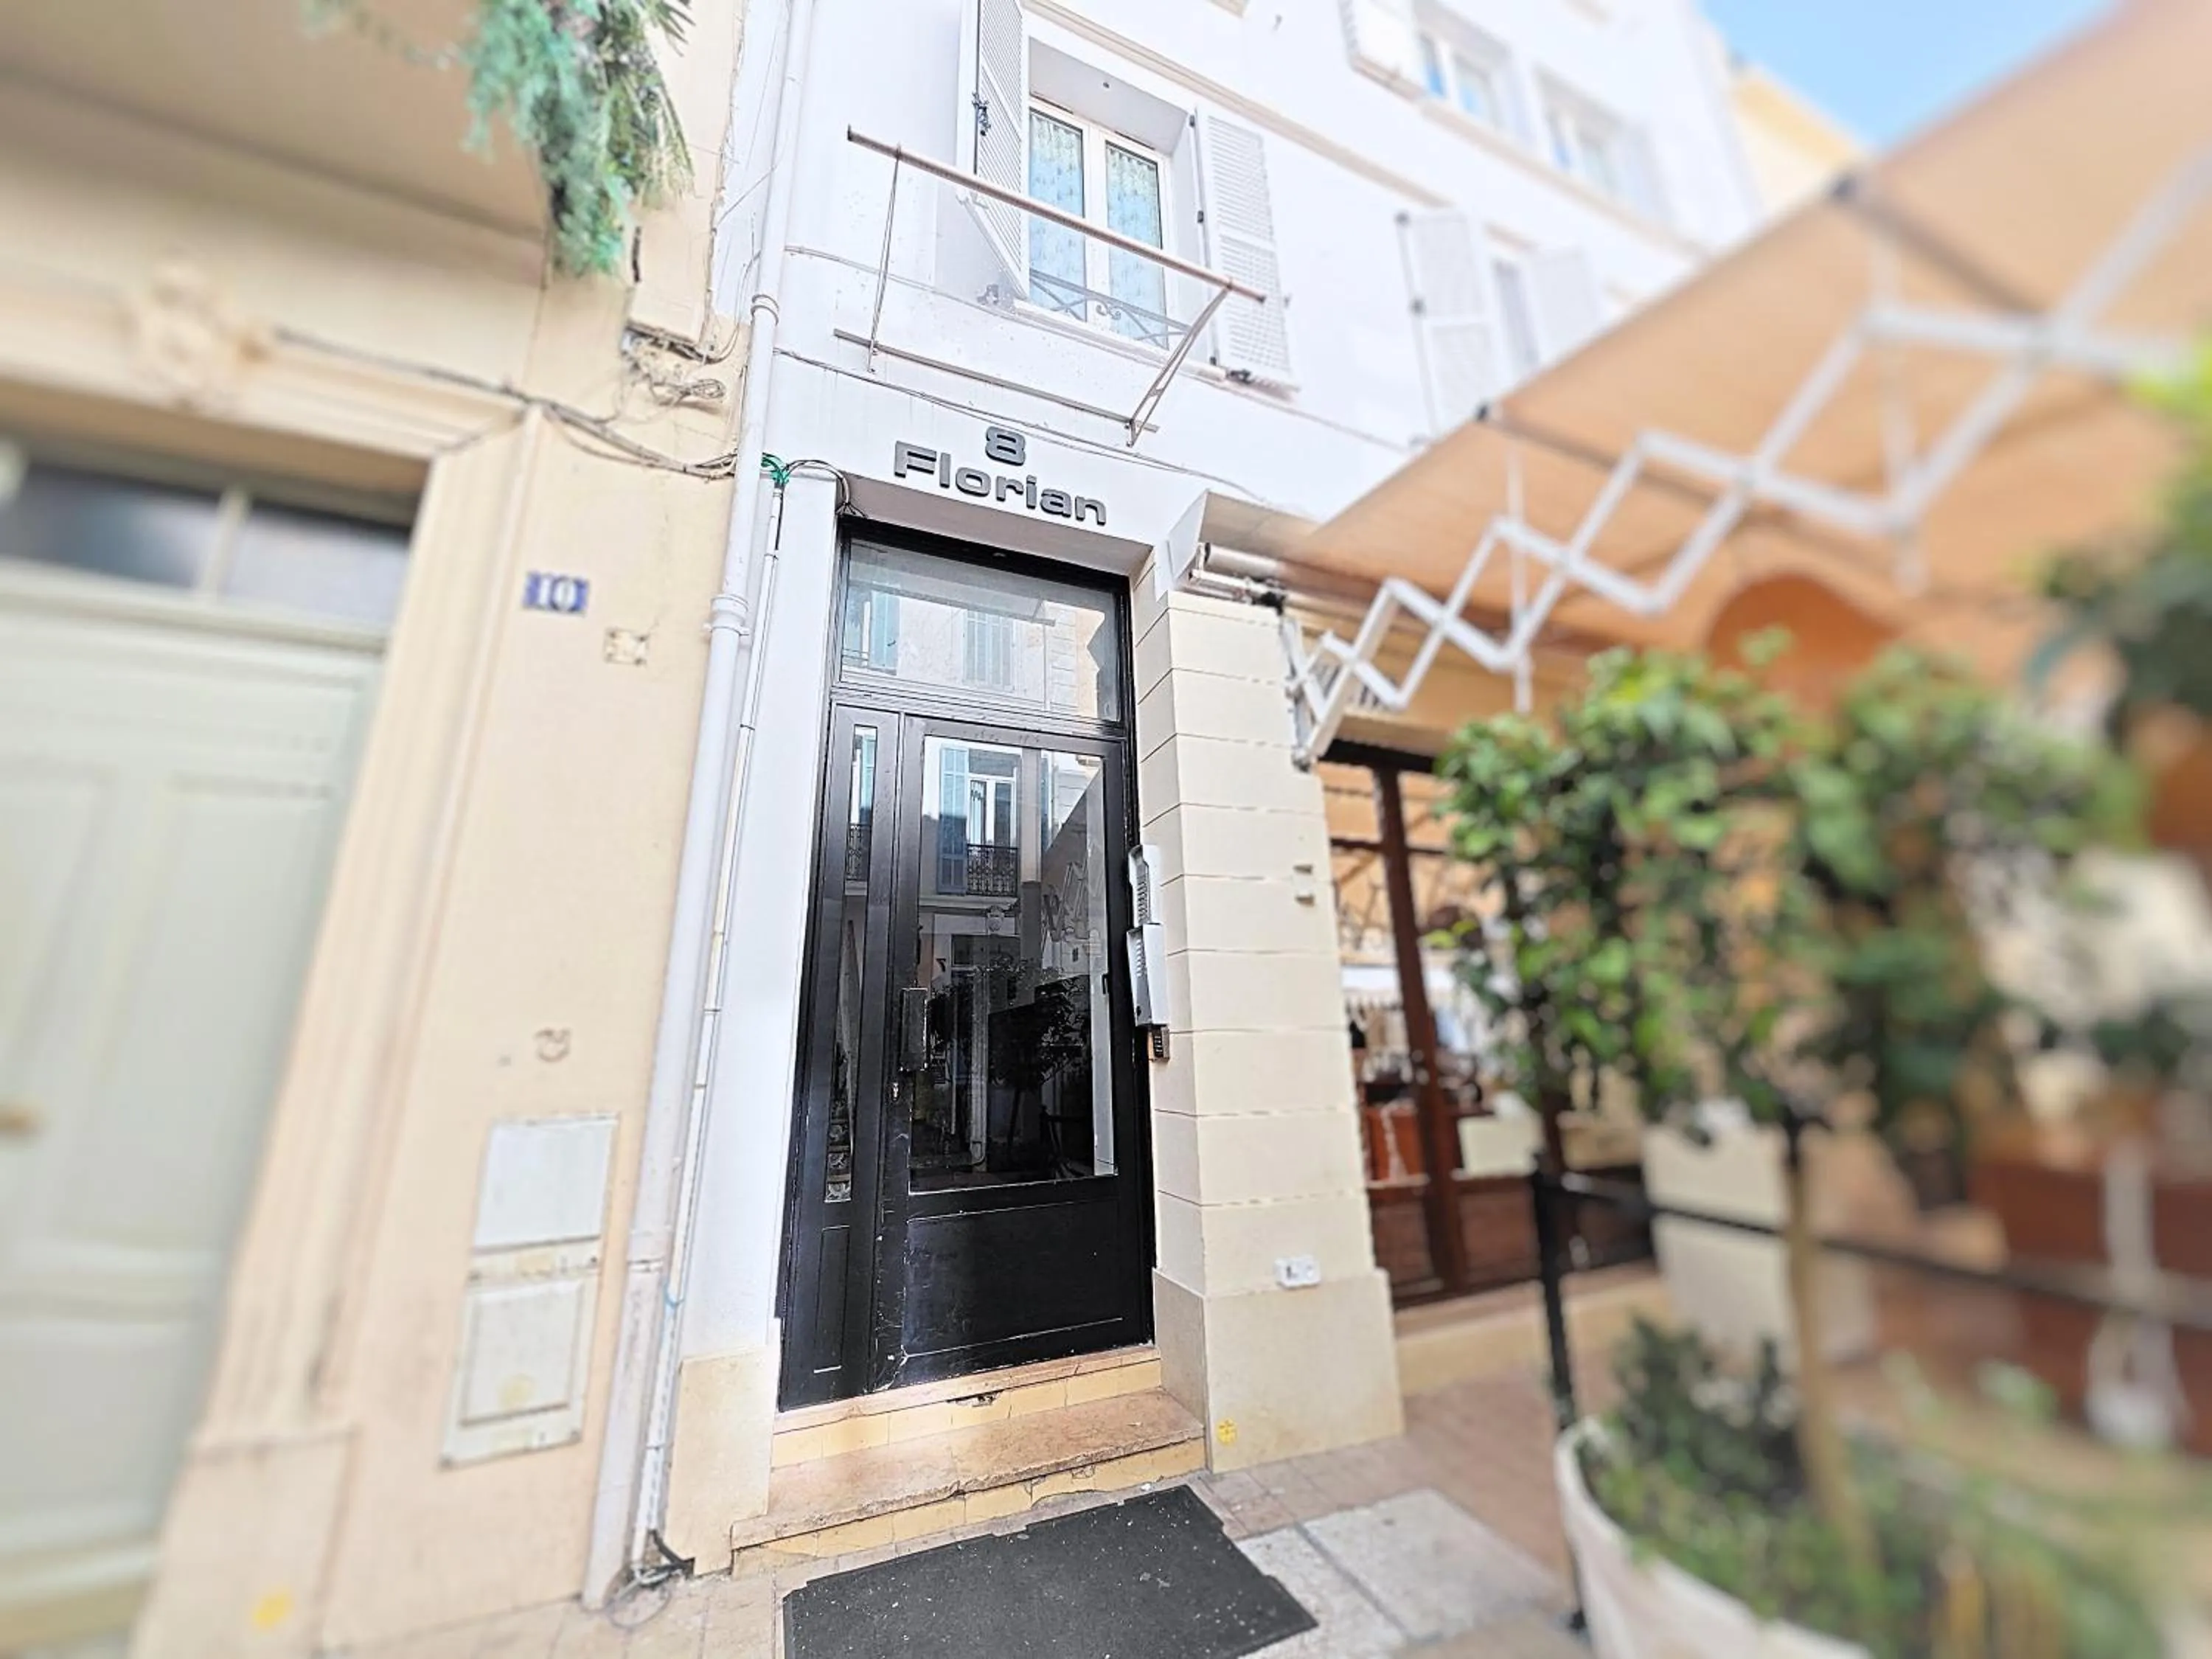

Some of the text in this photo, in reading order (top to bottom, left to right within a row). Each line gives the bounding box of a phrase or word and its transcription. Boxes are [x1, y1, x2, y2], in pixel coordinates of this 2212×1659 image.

[985, 425, 1026, 466] 8
[894, 440, 1107, 526] Florian
[538, 575, 577, 613] 10
